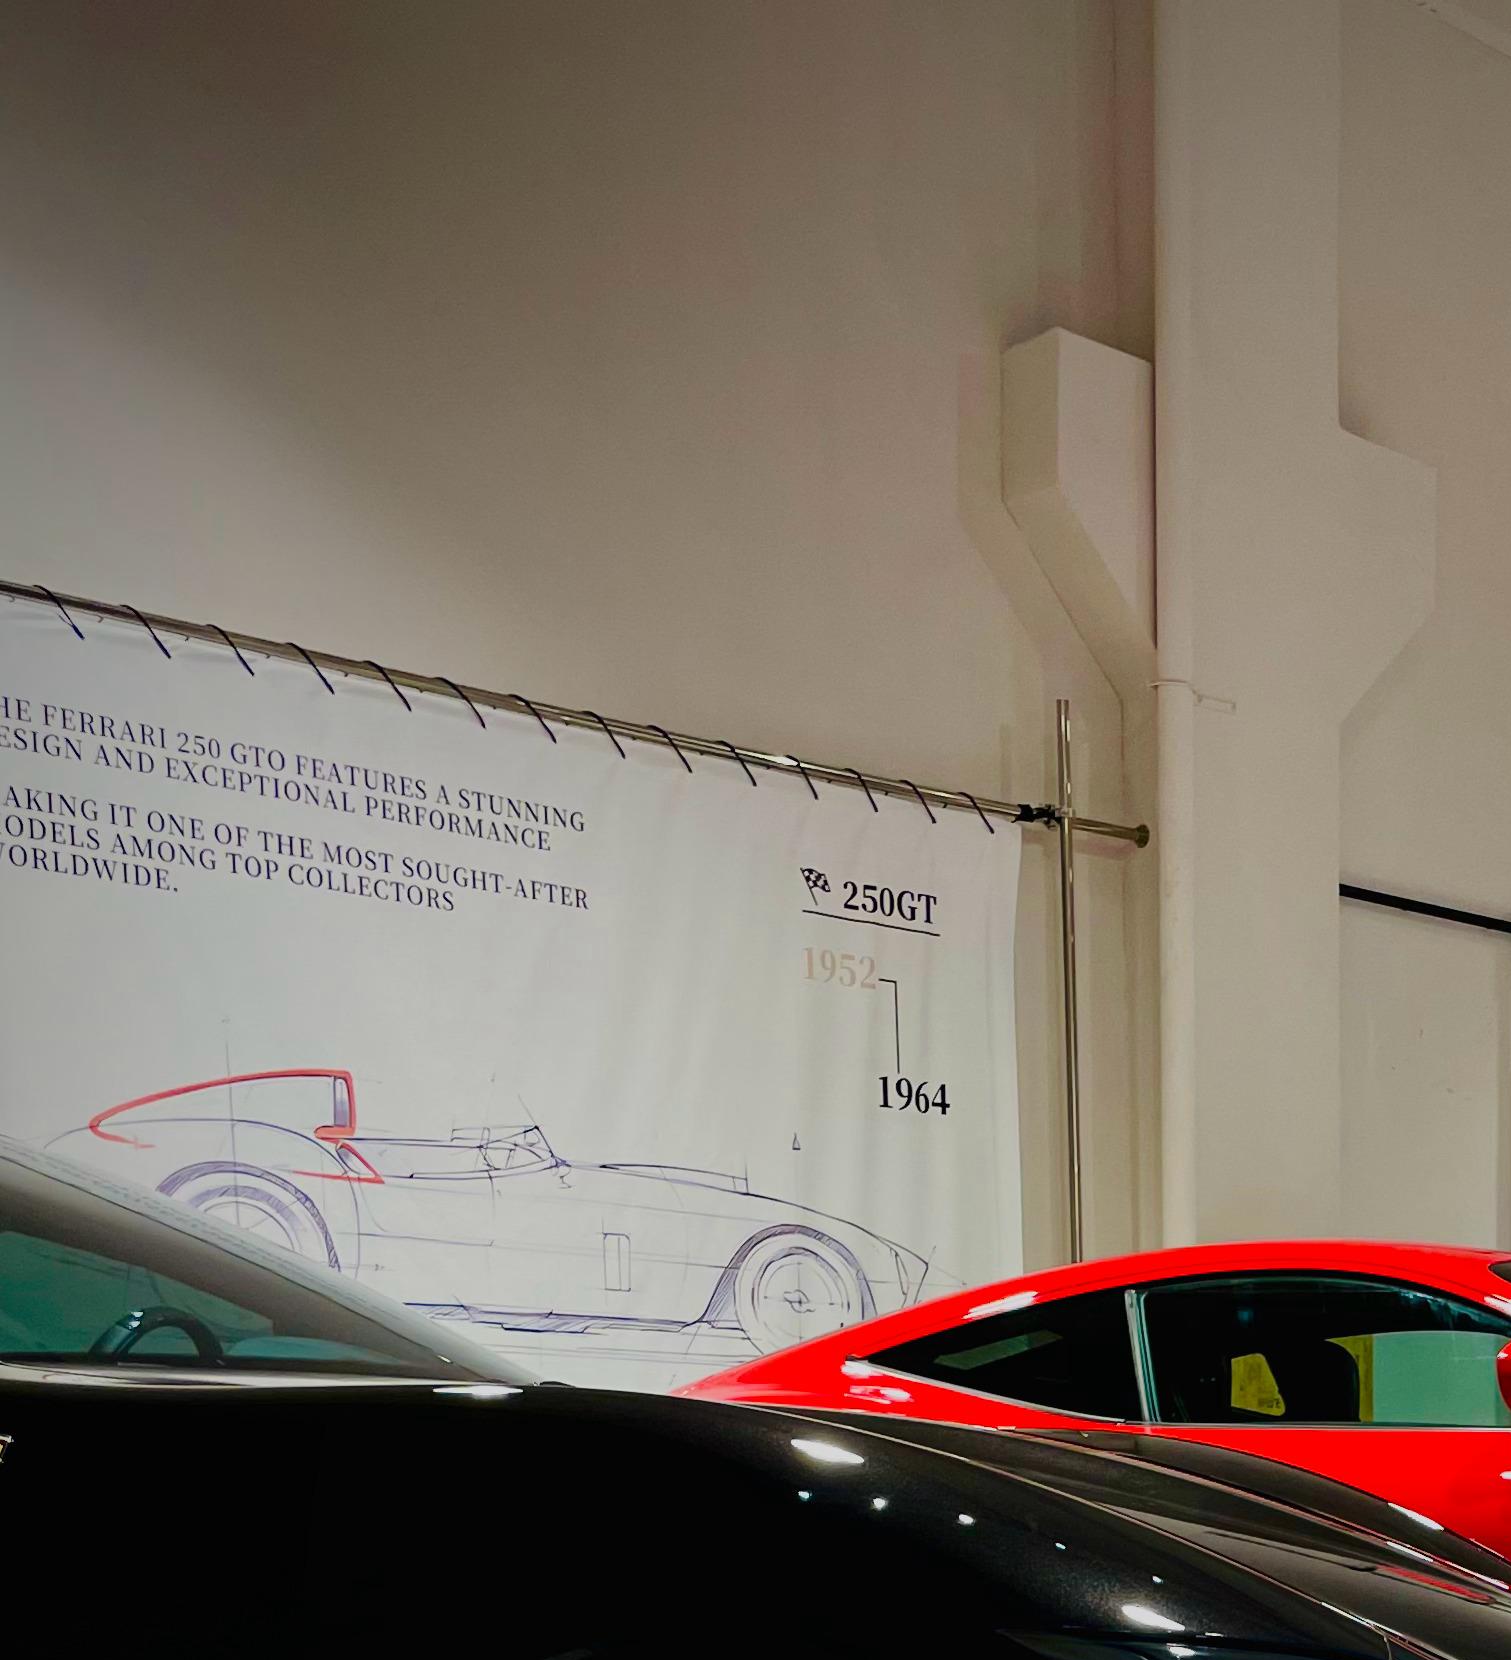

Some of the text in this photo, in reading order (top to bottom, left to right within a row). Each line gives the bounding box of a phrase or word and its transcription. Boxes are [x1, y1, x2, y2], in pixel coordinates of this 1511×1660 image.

[0, 696, 585, 832] HE FERRARI 250 GTO FEATURES A STUNNING
[0, 725, 551, 851] ESIGN AND EXCEPTIONAL PERFORMANCE
[0, 814, 454, 911] ODELS AMONG TOP COLLECTORS
[0, 842, 178, 892] ORLDWIDE.
[3, 785, 589, 910] AKING IT ONE OF THE MOST SOUGHT-AFTER
[843, 881, 937, 925] 250GT
[803, 947, 877, 989] 1952
[878, 1076, 950, 1115] 1964
